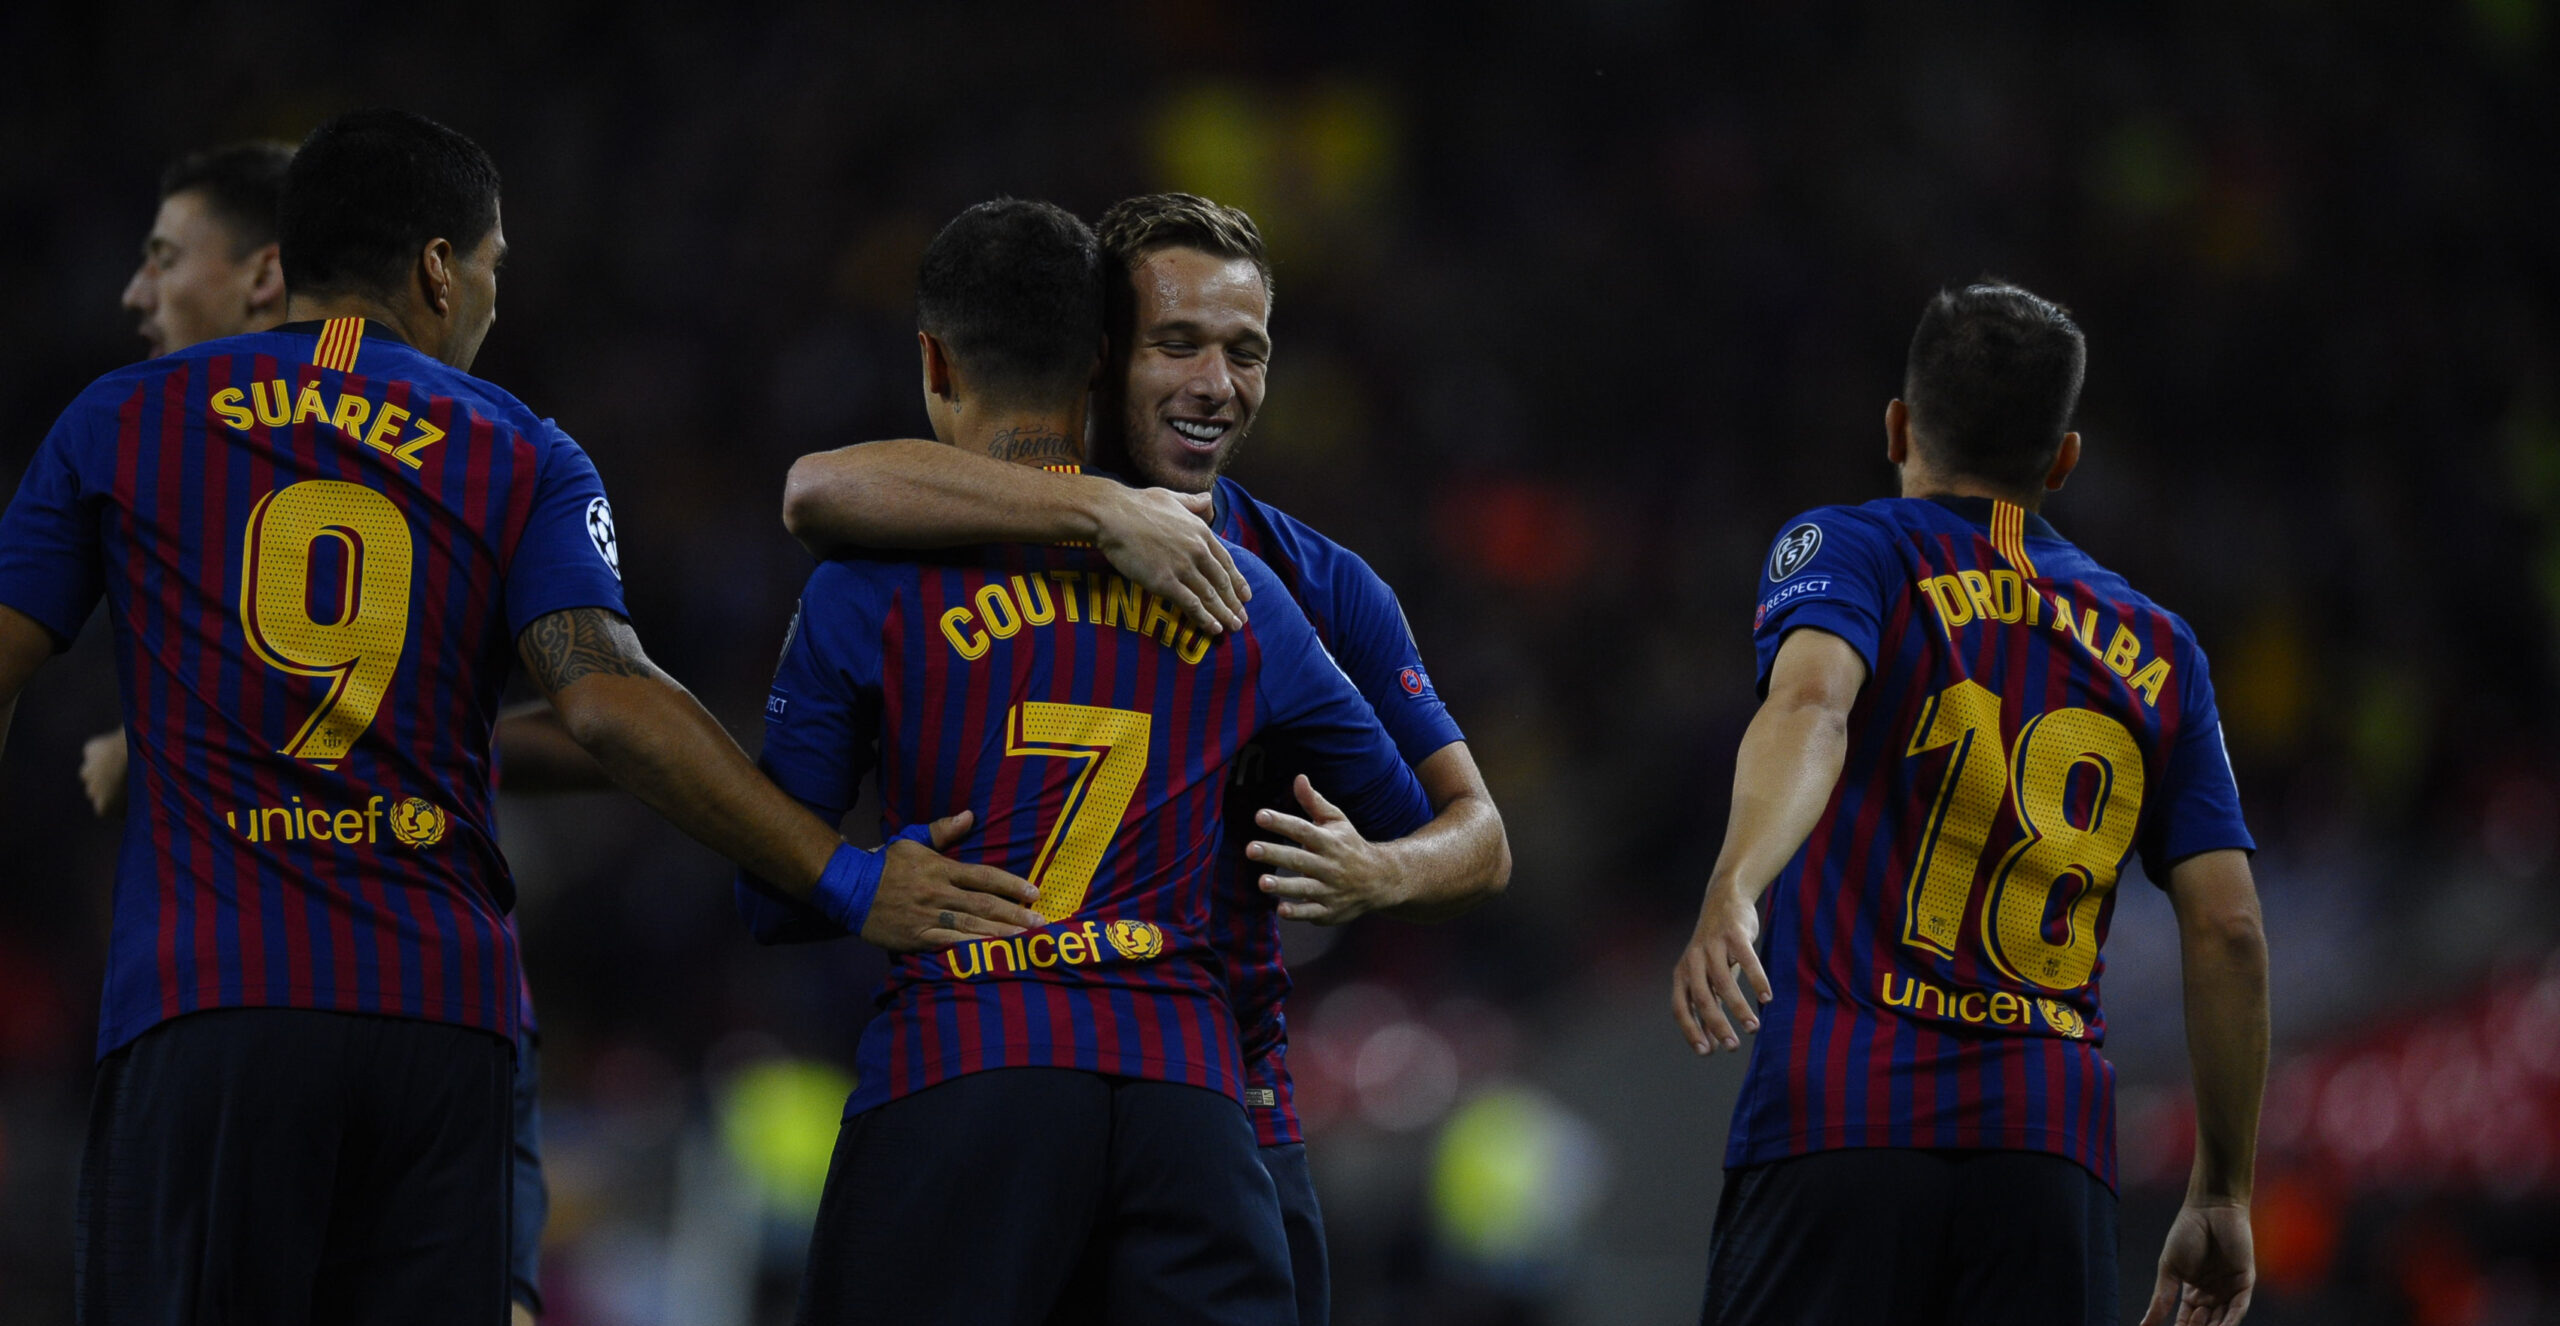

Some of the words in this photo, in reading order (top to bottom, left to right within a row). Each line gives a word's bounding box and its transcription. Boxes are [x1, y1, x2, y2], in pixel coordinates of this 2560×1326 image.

[211, 379, 446, 470] SUÁREZ
[1766, 581, 1831, 613] RESPECT
[1784, 548, 1799, 566] 5
[240, 479, 413, 771] 9
[1006, 701, 1152, 924] 7
[1902, 678, 2145, 990] 18
[946, 921, 1101, 980] unicef
